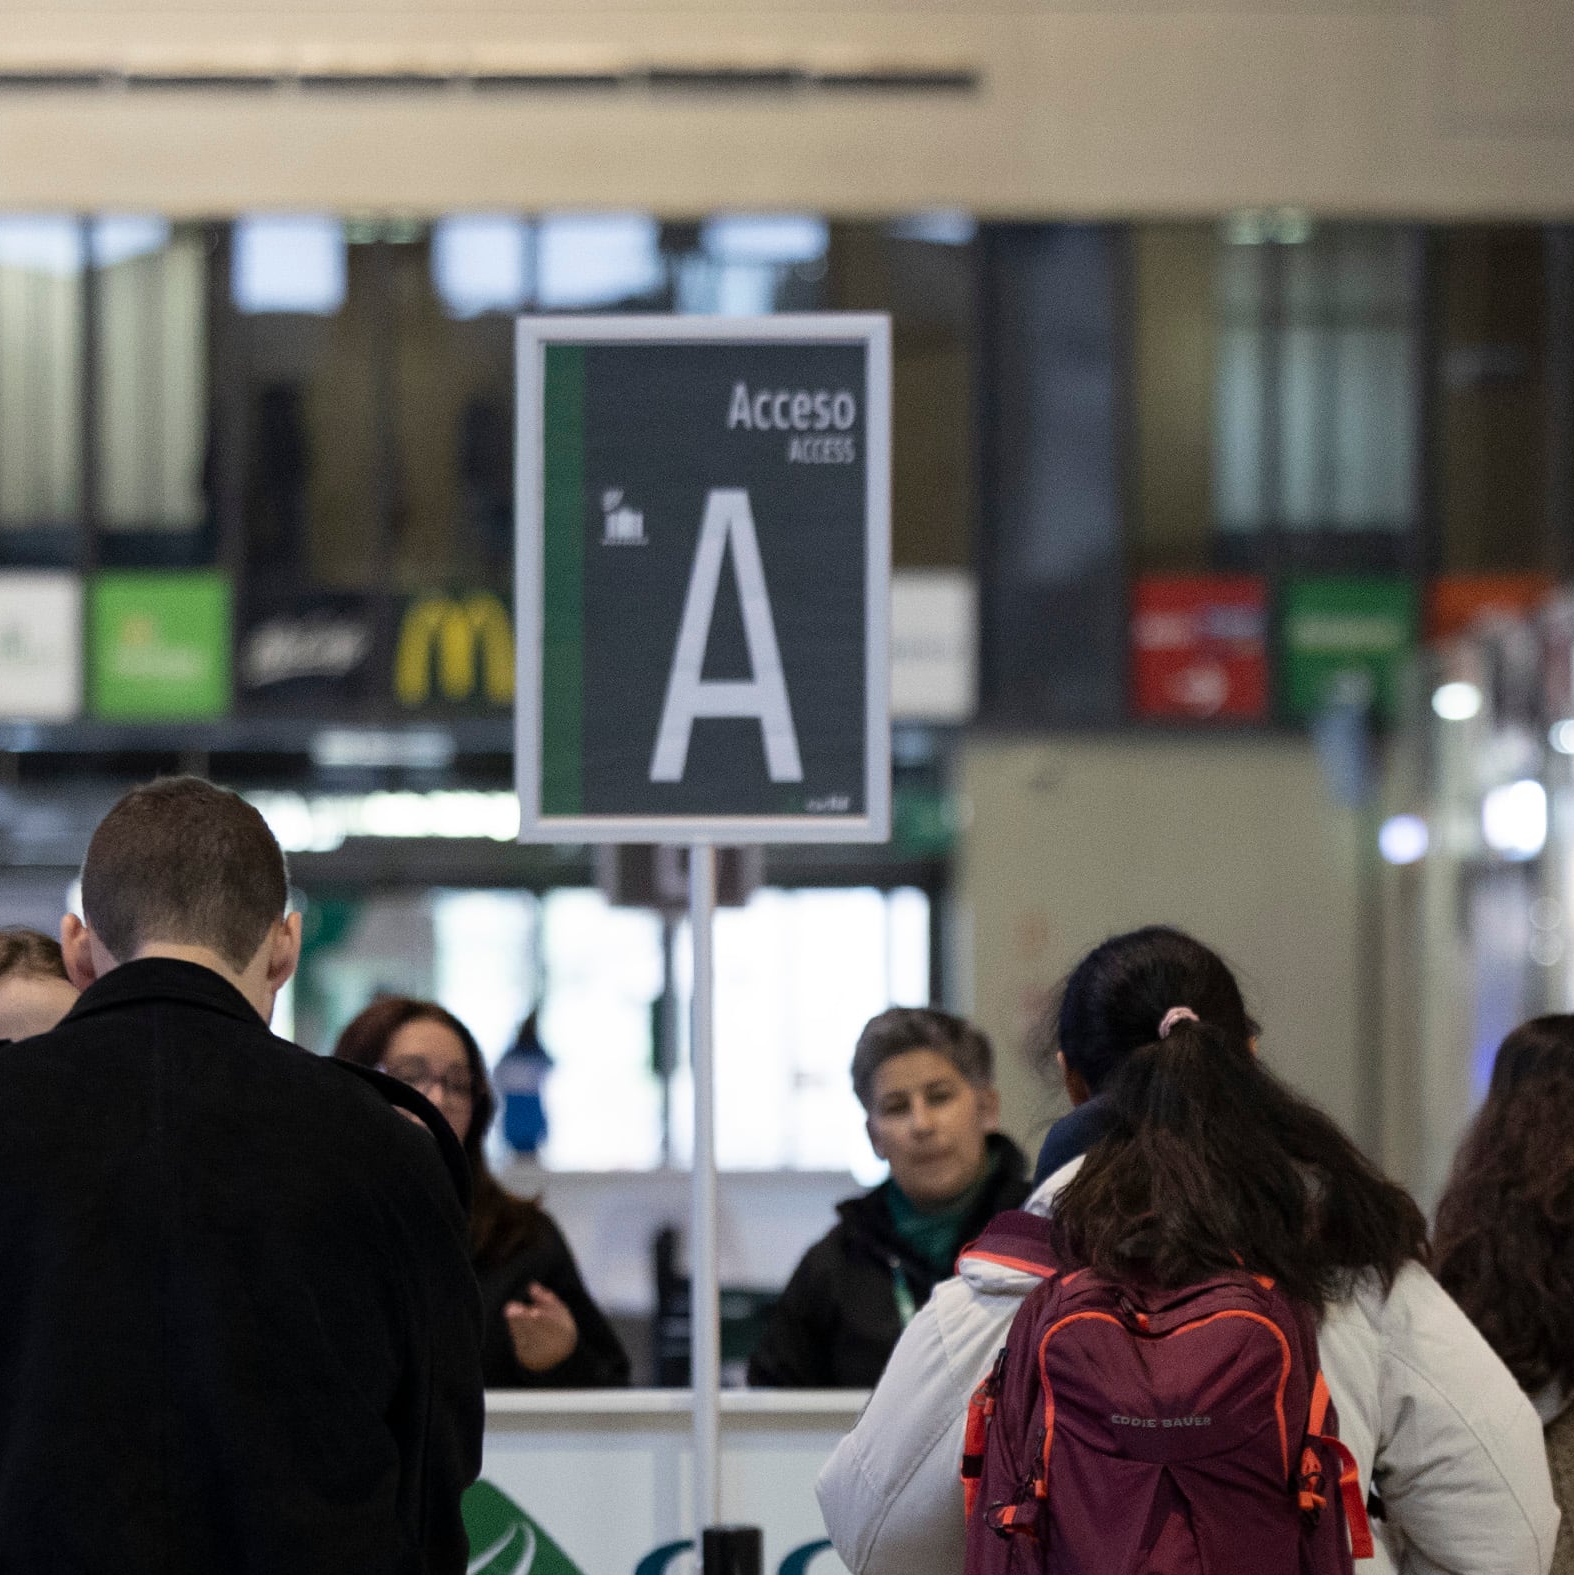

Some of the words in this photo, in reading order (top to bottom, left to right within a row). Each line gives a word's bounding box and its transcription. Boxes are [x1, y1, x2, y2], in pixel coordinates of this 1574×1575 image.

[727, 382, 856, 431] Acceso
[788, 436, 856, 464] ACCESS
[649, 487, 804, 783] A
[1111, 1414, 1156, 1428] EDDIE
[1161, 1416, 1211, 1428] BAUER
